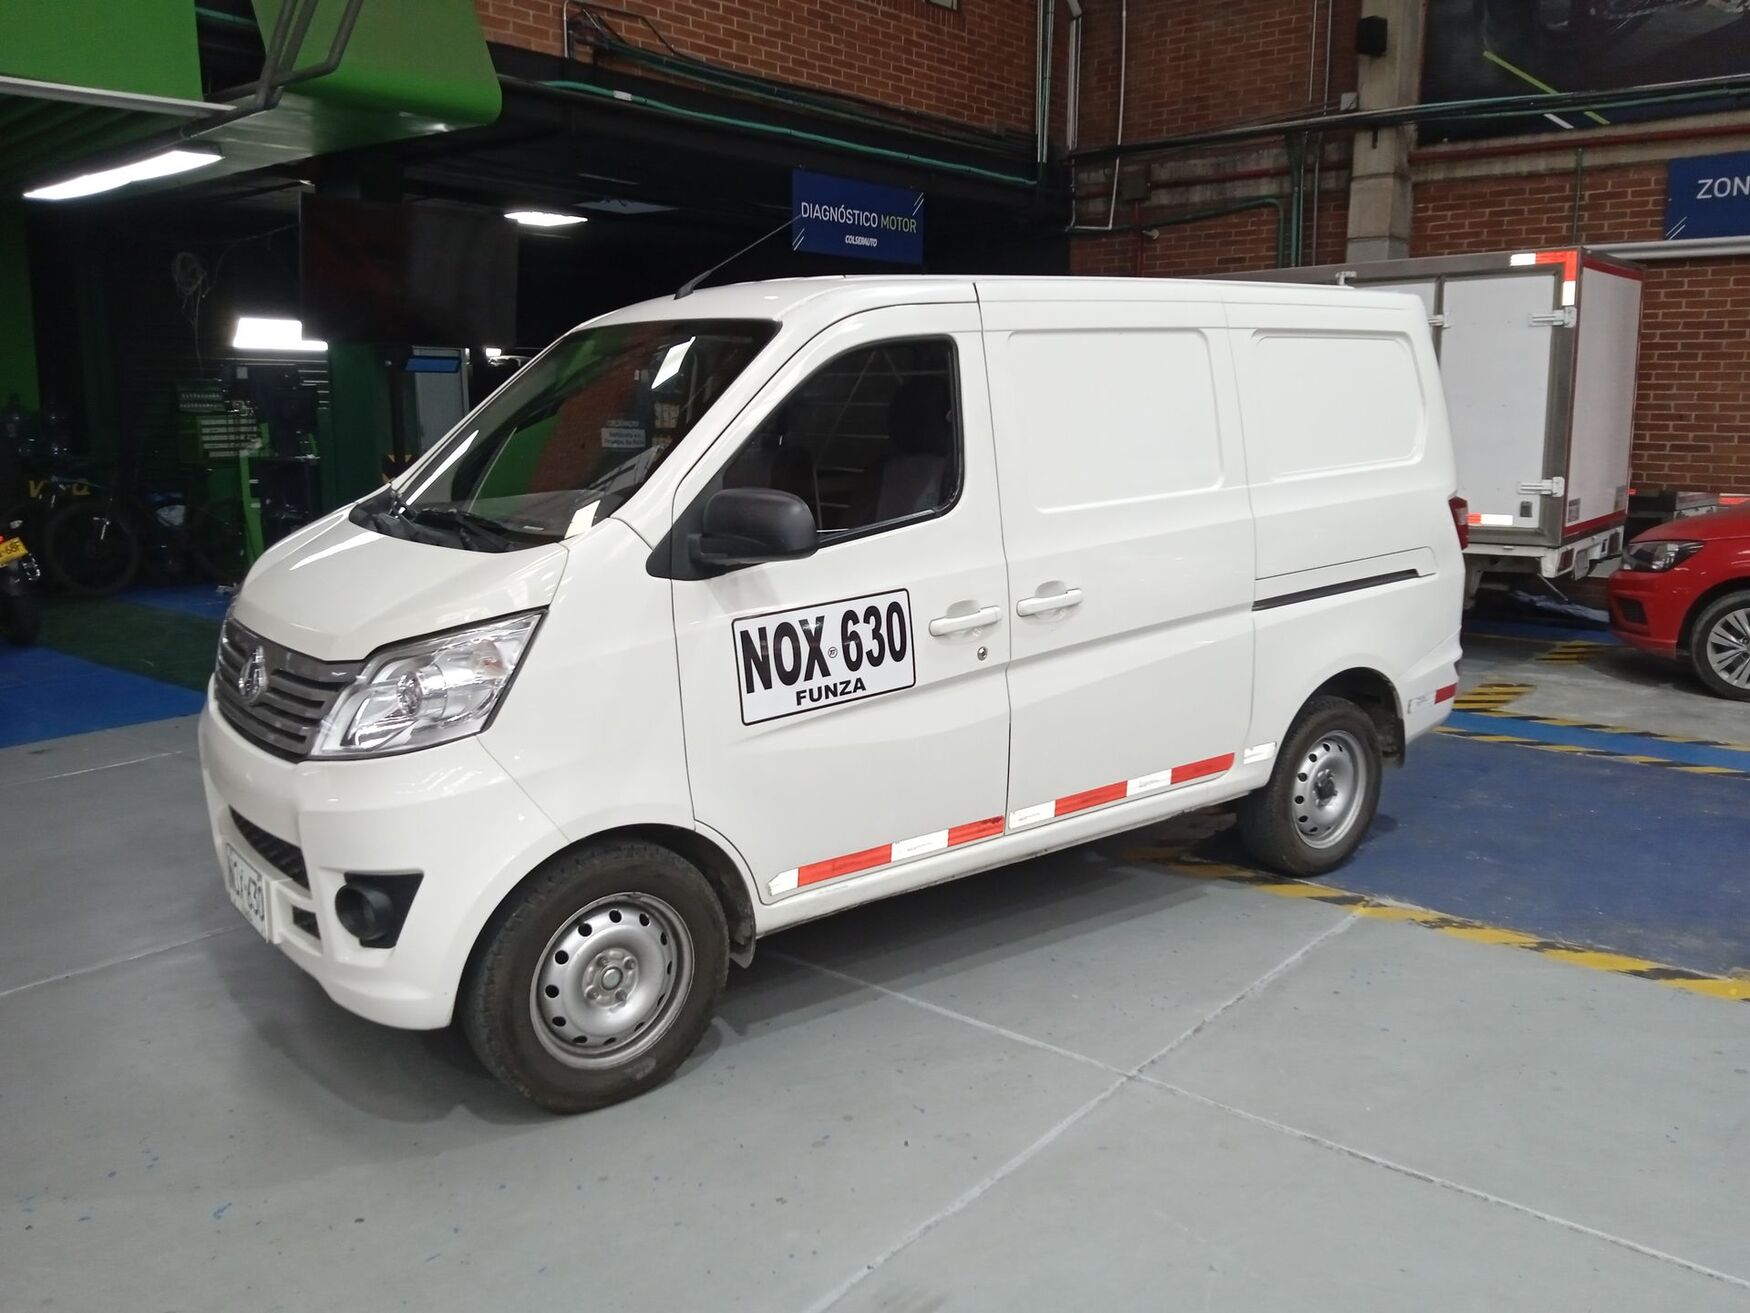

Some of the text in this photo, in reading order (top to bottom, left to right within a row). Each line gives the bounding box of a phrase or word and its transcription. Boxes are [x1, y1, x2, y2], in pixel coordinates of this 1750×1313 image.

[801, 201, 917, 233] DIAGNÓSTICO MOTOR
[845, 235, 878, 248] COLSERAUTO
[740, 601, 907, 694] NOX 630
[795, 677, 867, 706] FUNZA
